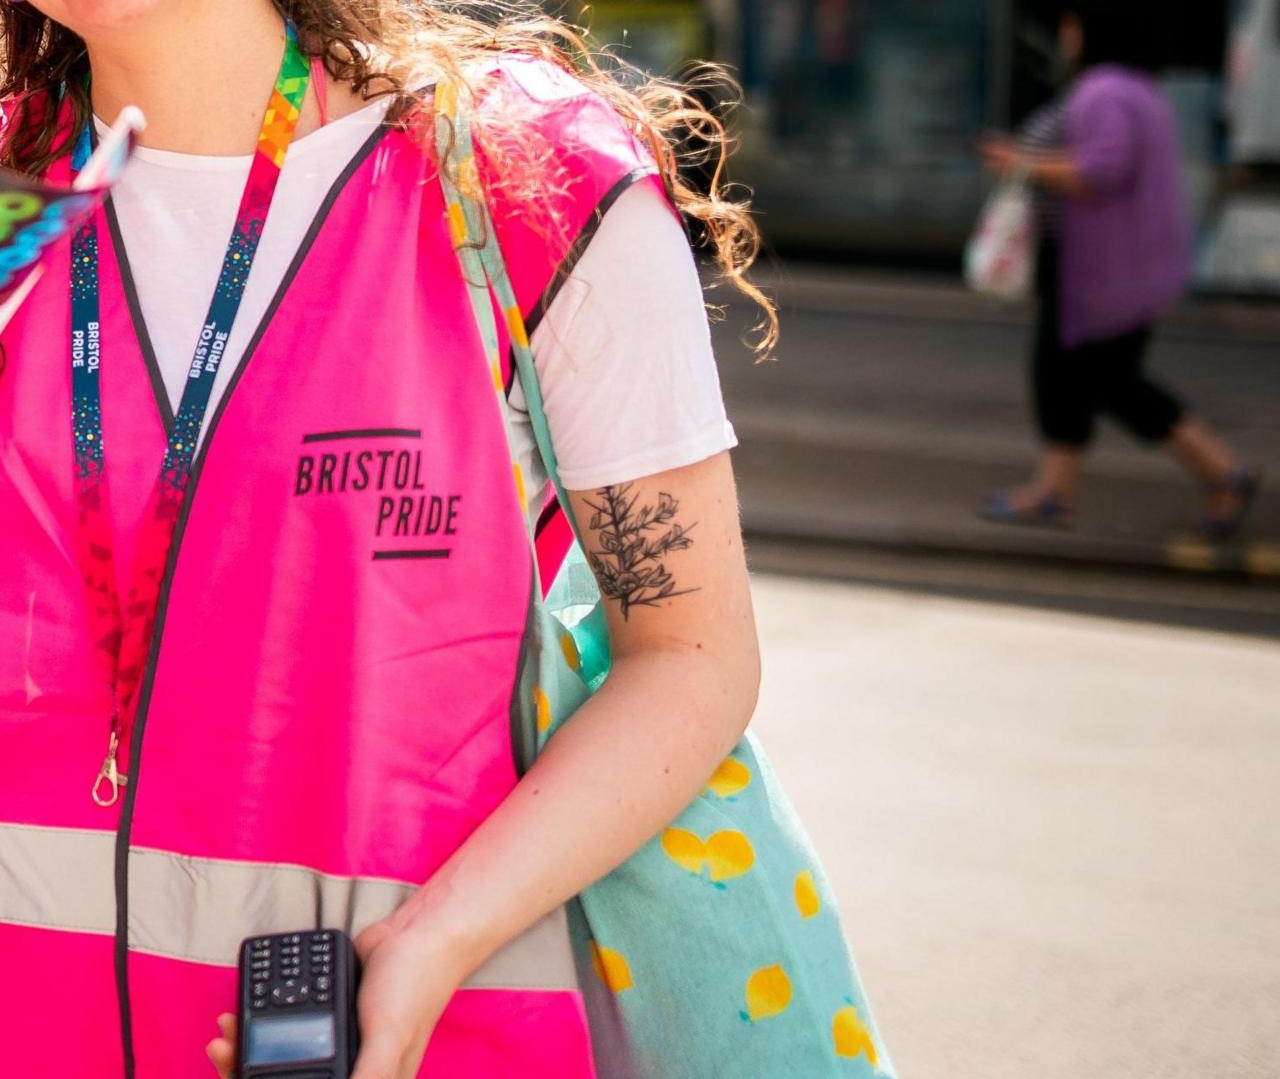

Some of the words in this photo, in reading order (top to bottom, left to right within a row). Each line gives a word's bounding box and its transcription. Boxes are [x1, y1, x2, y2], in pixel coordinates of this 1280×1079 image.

[72, 330, 84, 368] PRIDE
[88, 322, 100, 374] BRISTOL
[190, 321, 217, 378] BRISTOL
[205, 331, 228, 372] PRIDE
[294, 450, 425, 496] BRISTOL
[376, 495, 461, 536] PRIDE
